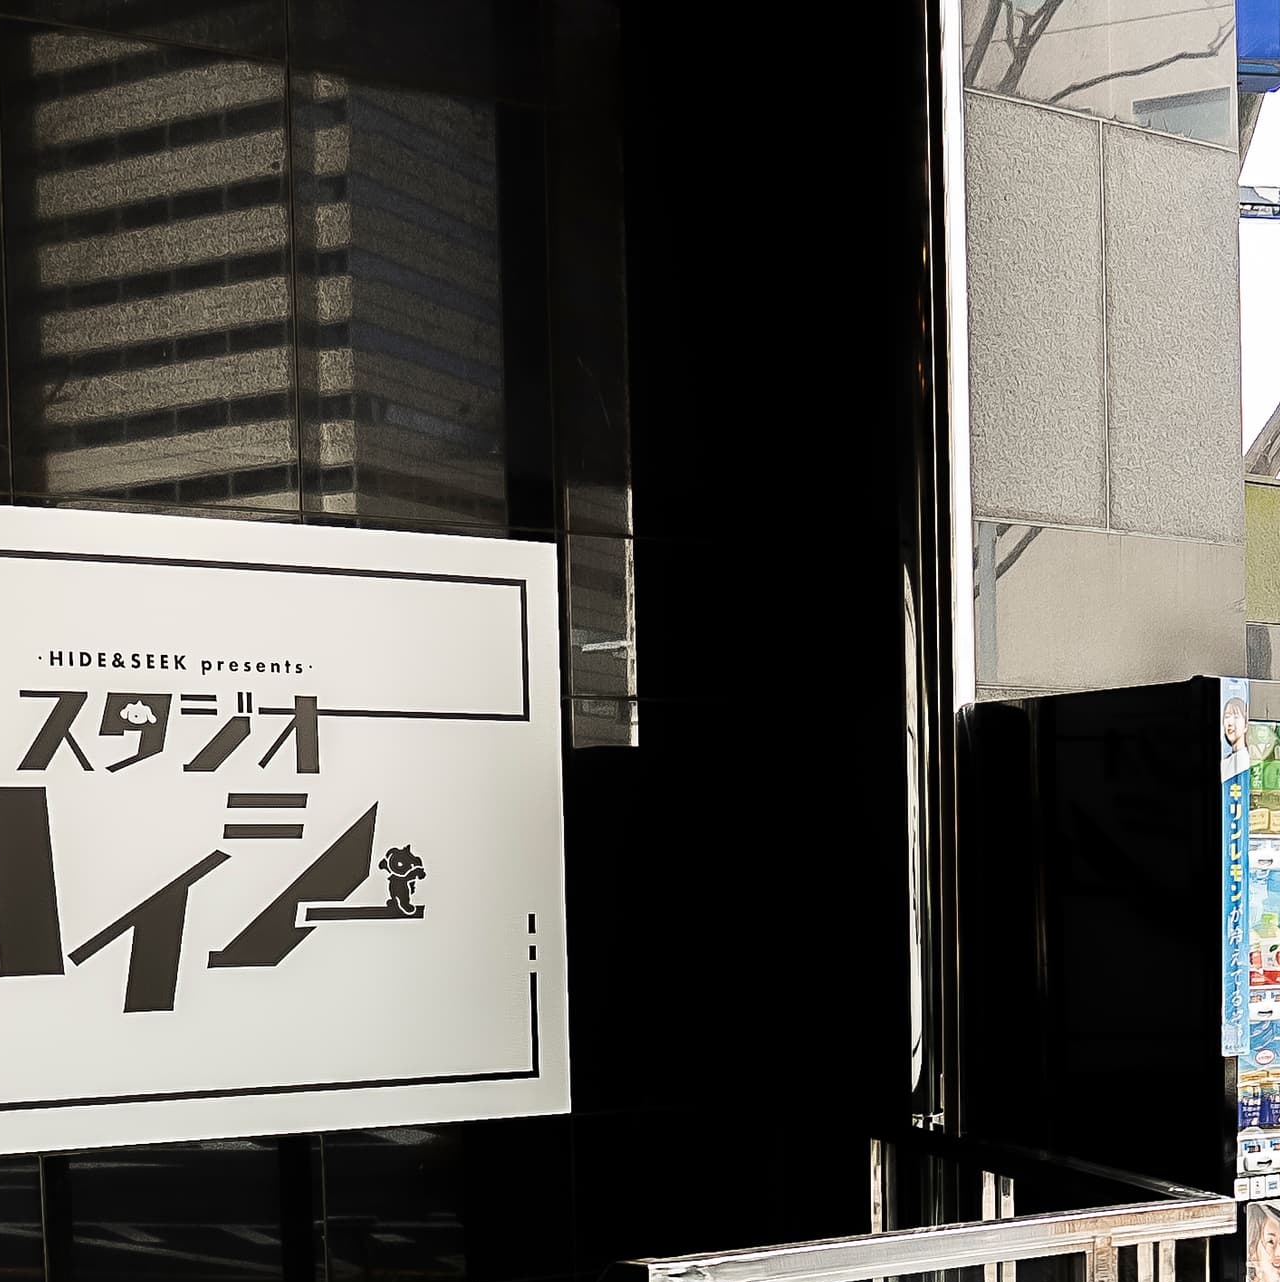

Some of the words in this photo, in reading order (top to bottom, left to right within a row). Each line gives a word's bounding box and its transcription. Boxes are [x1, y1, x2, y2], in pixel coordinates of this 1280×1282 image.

[49, 650, 187, 670] HIDE&SEEK
[200, 657, 304, 676] presents
[17, 689, 321, 774] スタジオ
